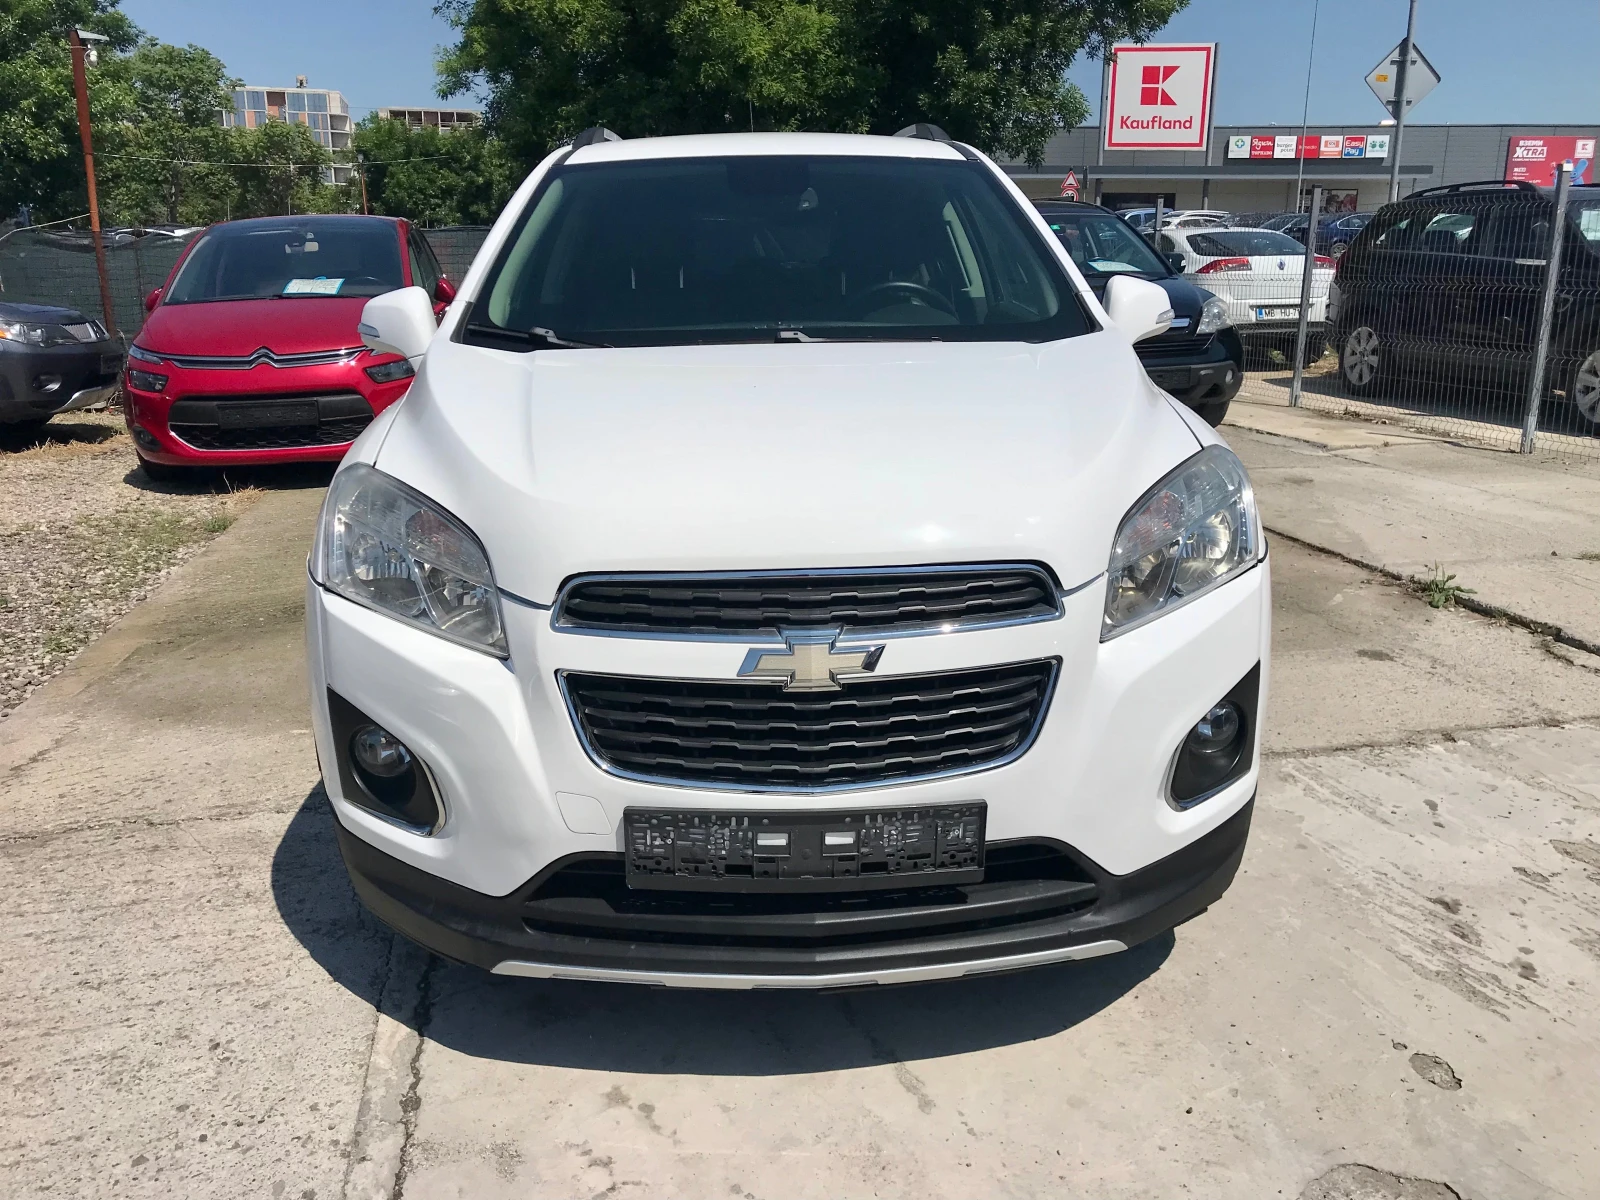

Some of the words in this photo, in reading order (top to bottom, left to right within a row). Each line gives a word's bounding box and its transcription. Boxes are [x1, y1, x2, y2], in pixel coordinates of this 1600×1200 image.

[1119, 115, 1193, 130] Kaufland
[1345, 139, 1364, 148] Easy
[1344, 148, 1360, 156] Pay
[1513, 147, 1547, 157] XTRA
[1264, 308, 1275, 317] MB
